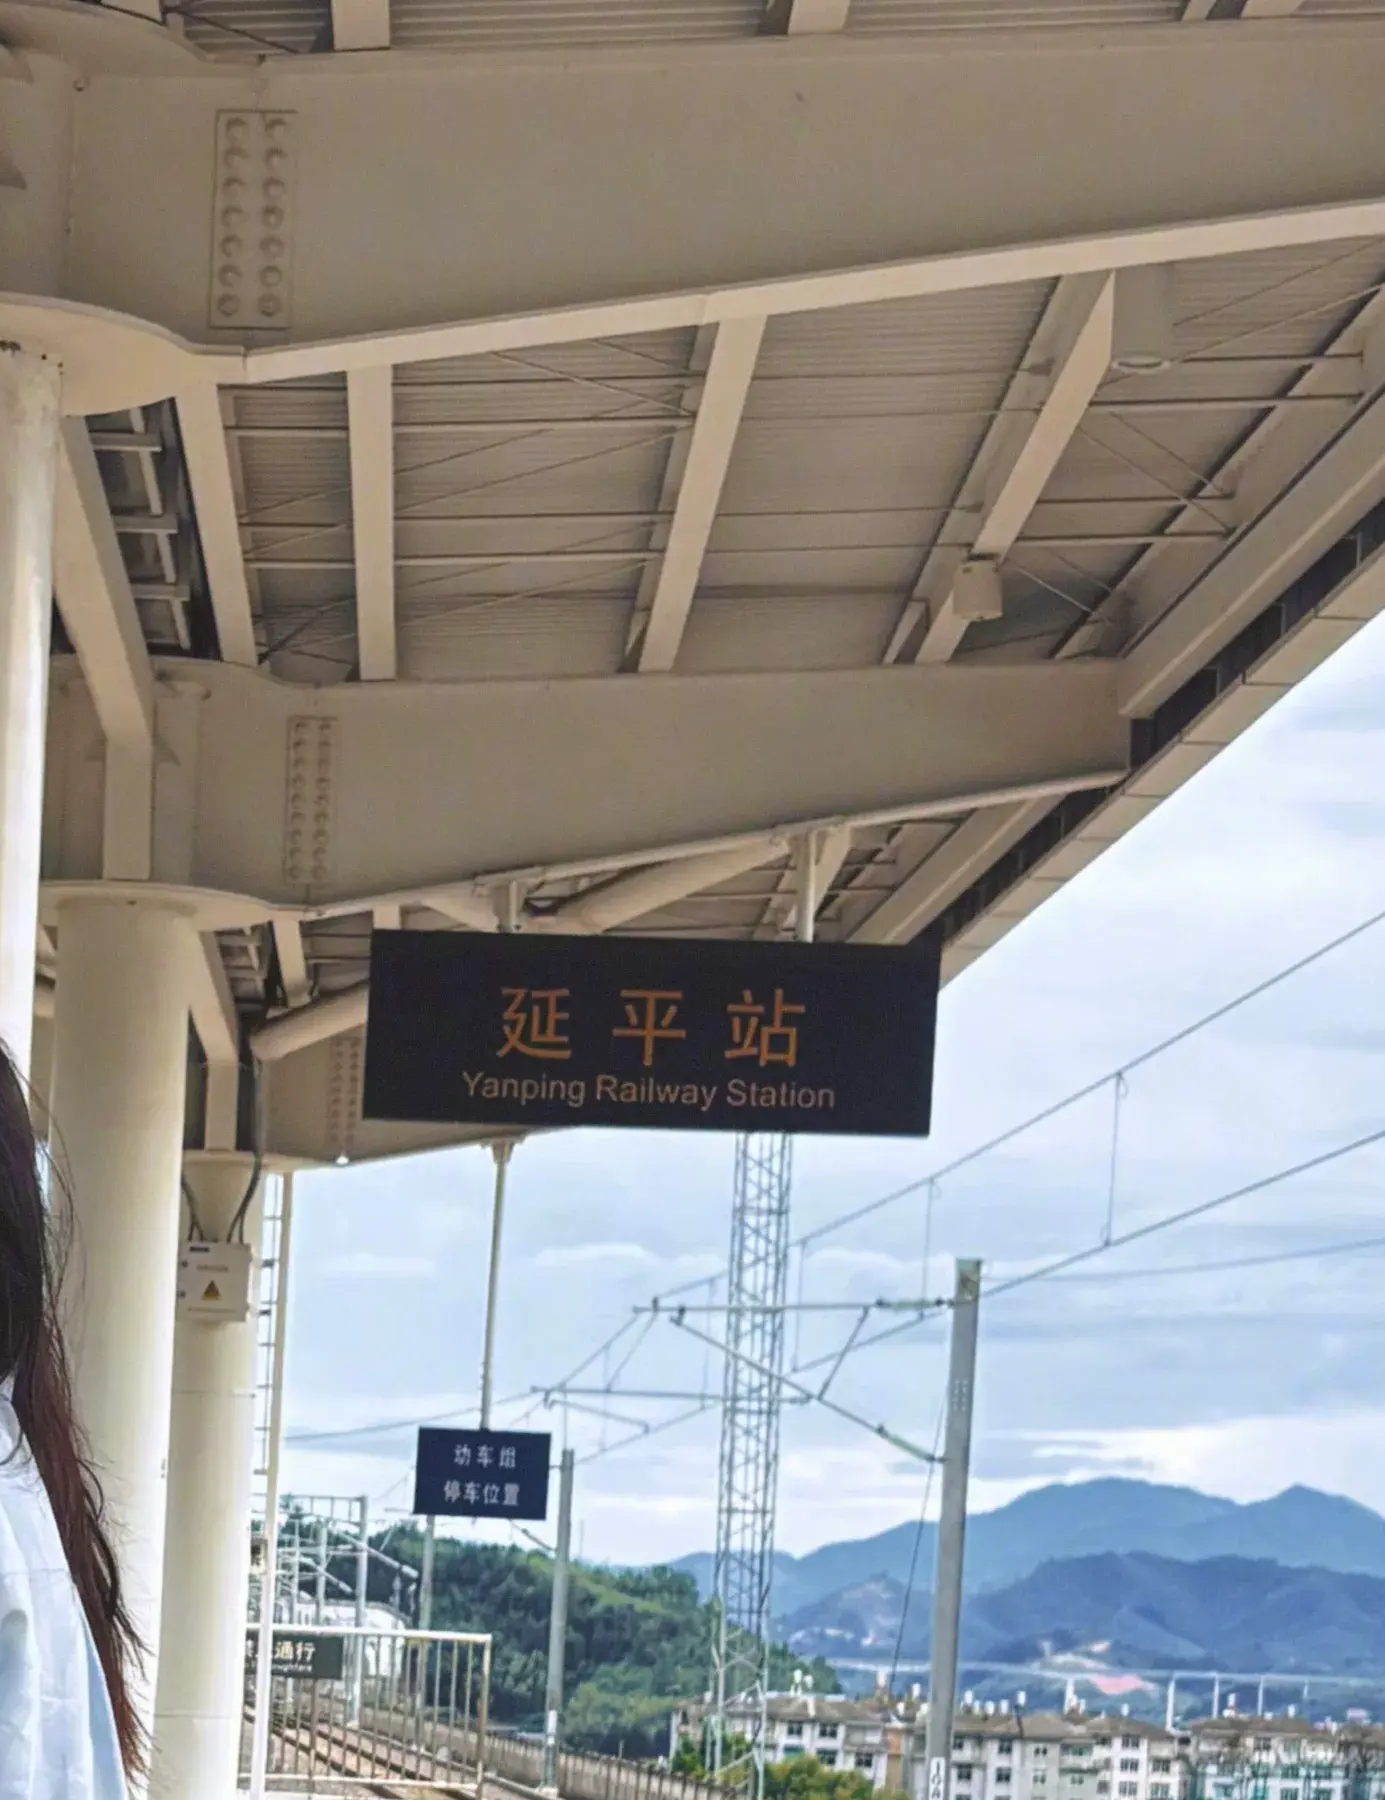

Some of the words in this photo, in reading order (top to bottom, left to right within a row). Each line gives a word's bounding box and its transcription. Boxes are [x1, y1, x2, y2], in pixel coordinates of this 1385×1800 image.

[496, 987, 806, 1068] 延平站
[463, 1071, 584, 1107] Yanping
[596, 1074, 716, 1111] Railway
[726, 1078, 835, 1109] Station
[454, 1444, 517, 1469] 动车组
[444, 1480, 520, 1506] 停车位置
